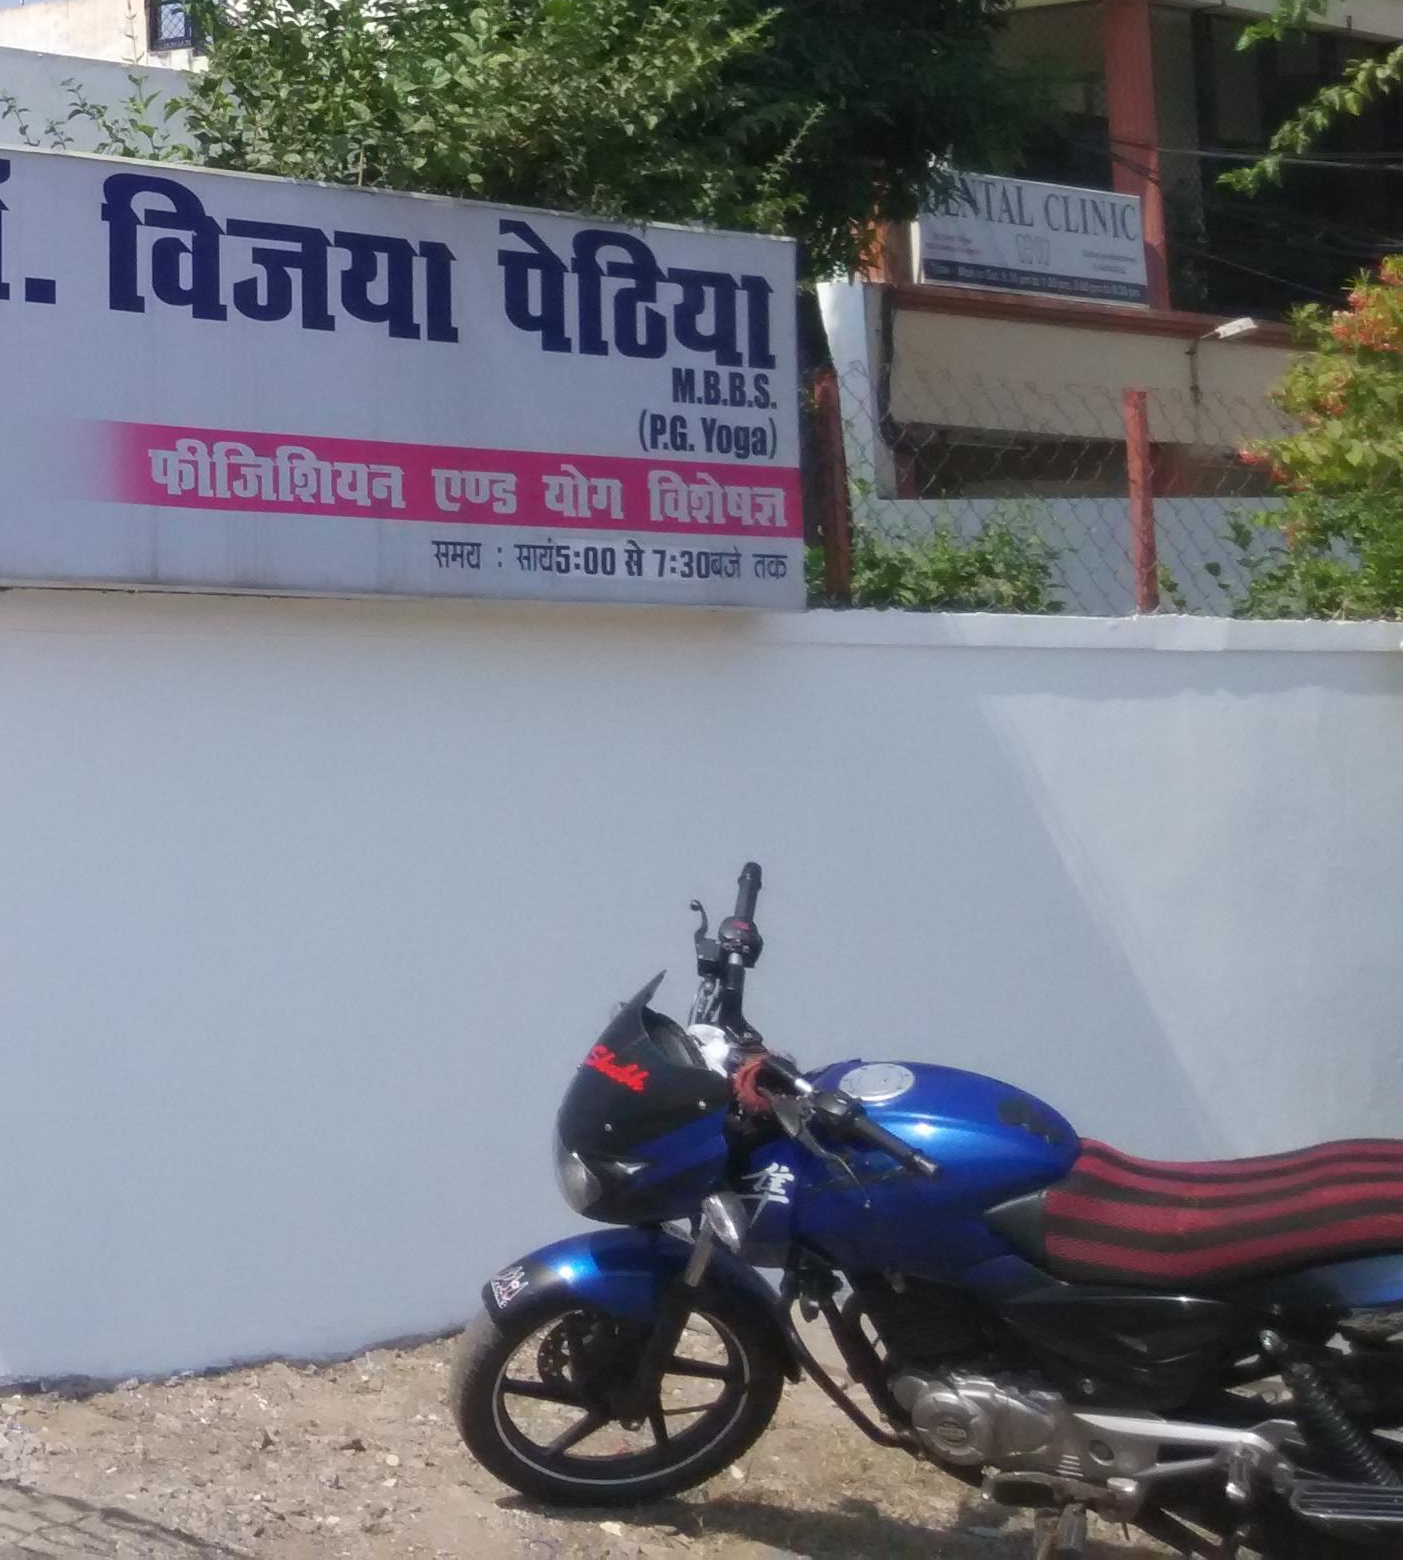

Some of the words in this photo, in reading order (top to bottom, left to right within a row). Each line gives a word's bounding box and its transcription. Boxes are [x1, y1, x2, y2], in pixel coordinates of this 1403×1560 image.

[1044, 192, 1139, 241] CLINIC
[100, 172, 459, 343] विजया
[671, 366, 778, 410] M.B.B.S.
[638, 407, 695, 453] (P.G.
[699, 416, 778, 460] Yoga)
[147, 437, 407, 509] फीजिशियन
[431, 467, 519, 515] एण्ड
[541, 463, 625, 521] योग
[647, 469, 788, 528] विशेषज्ञ
[431, 540, 482, 570] समय
[623, 539, 645, 577] से
[752, 553, 788, 580] तक
